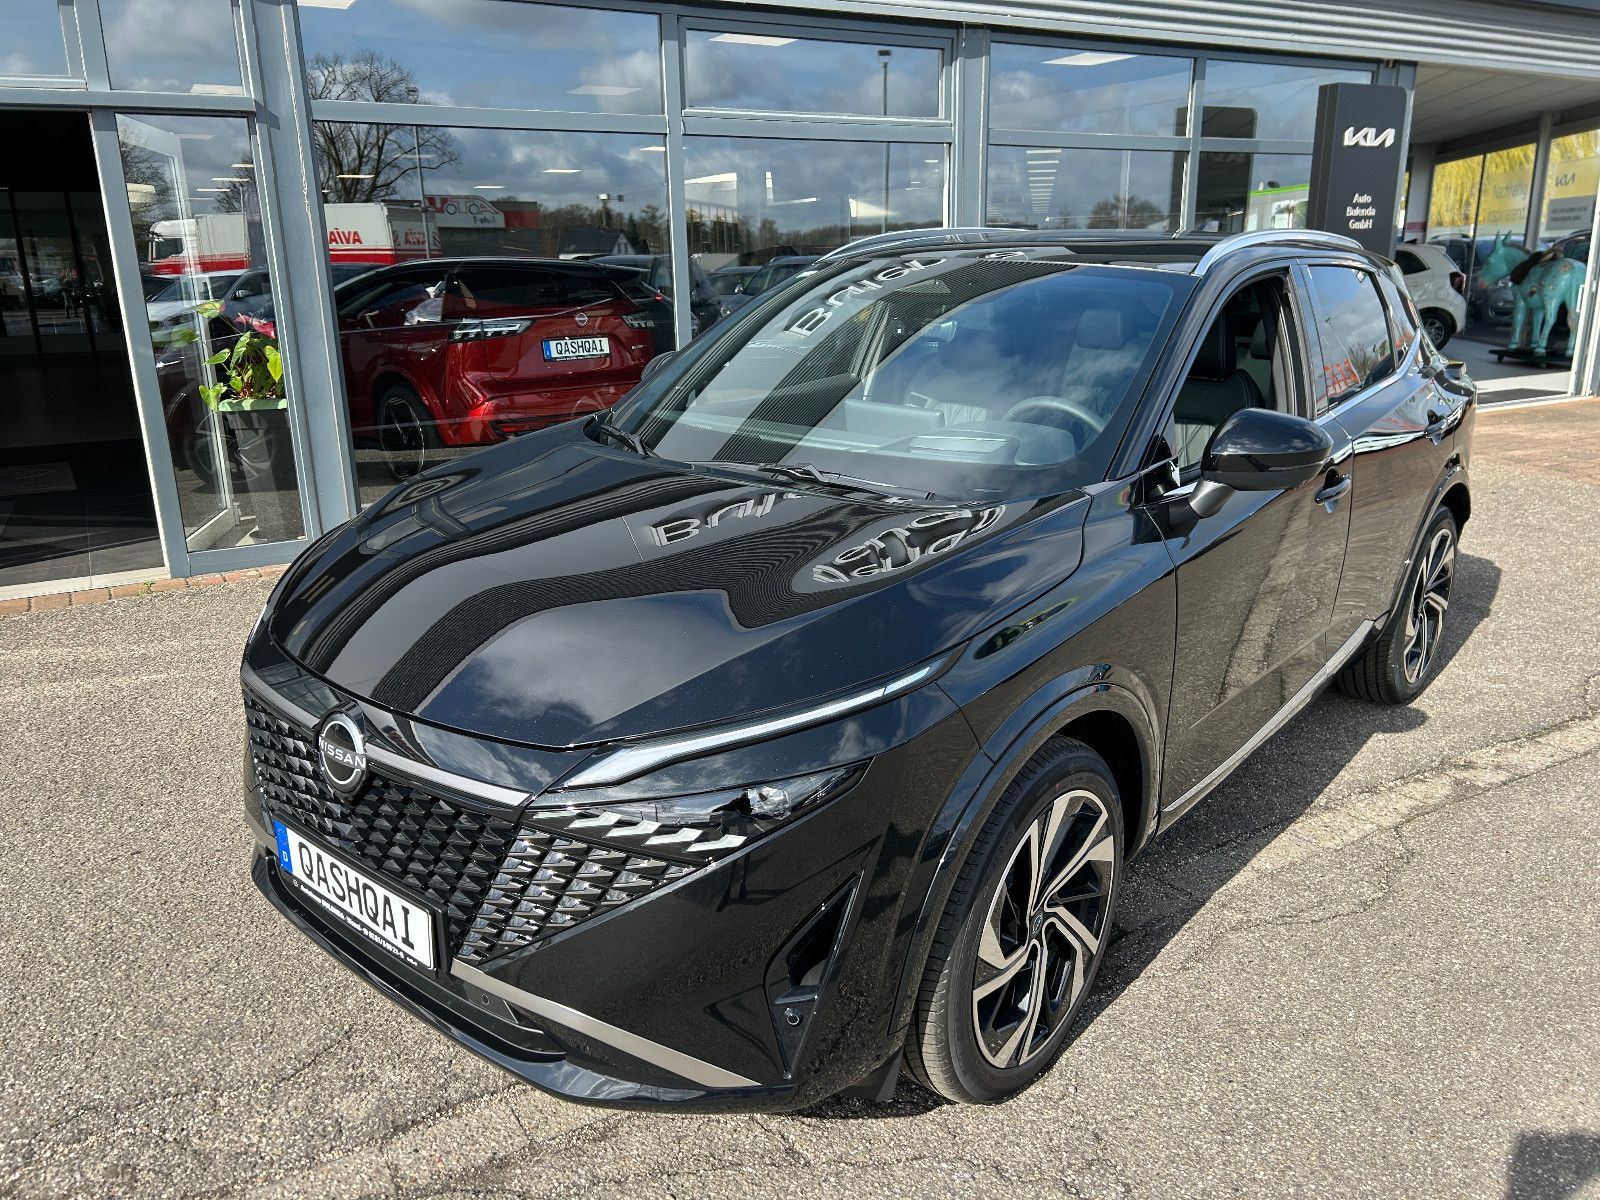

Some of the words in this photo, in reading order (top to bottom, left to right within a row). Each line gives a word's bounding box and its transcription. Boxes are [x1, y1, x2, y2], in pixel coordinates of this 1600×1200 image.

[1343, 127, 1395, 148] KIA
[1353, 193, 1371, 203] Auto
[1349, 219, 1373, 229] GmbH
[555, 340, 605, 355] QASHQAI
[319, 736, 366, 769] NISSAN
[298, 841, 415, 950] QASHQAI
